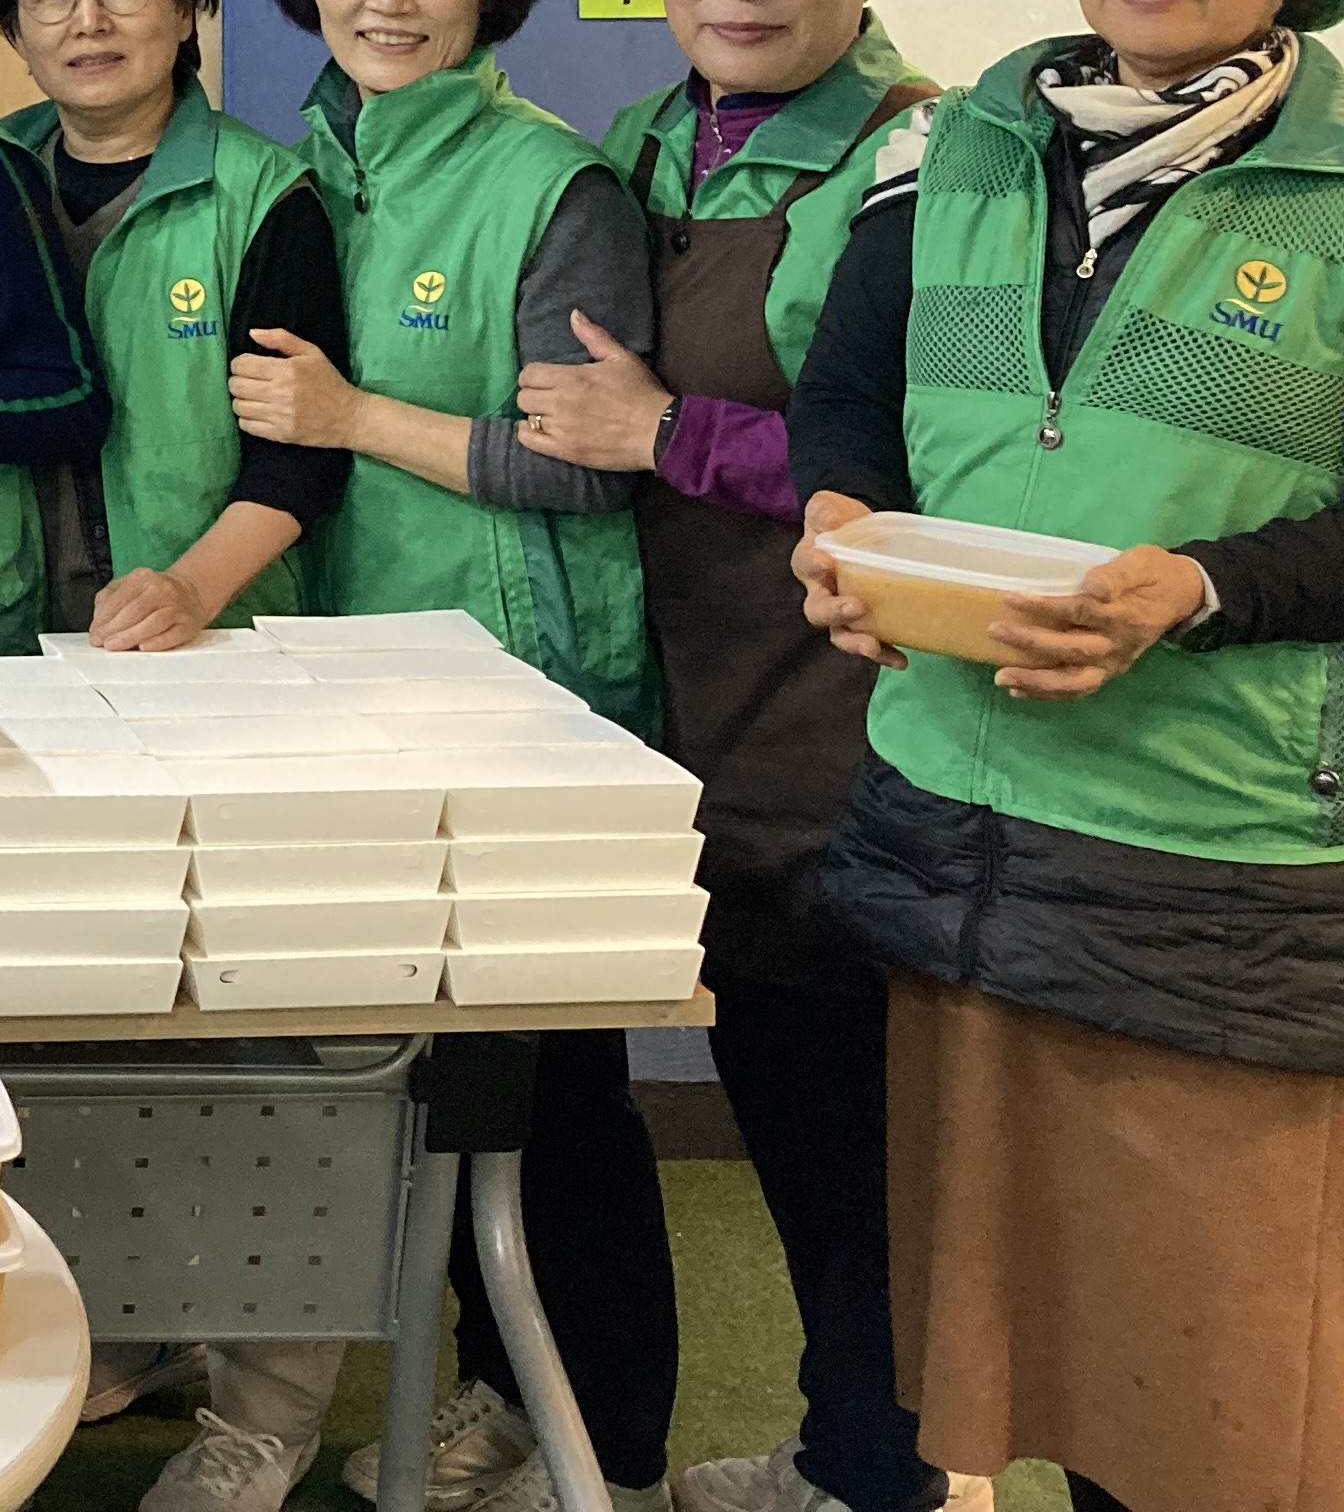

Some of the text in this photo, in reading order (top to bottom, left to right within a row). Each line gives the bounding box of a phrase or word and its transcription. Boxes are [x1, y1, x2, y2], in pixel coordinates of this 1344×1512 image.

[167, 320, 218, 339] SMU
[399, 310, 449, 331] SMU
[1209, 301, 1284, 342] SMU
